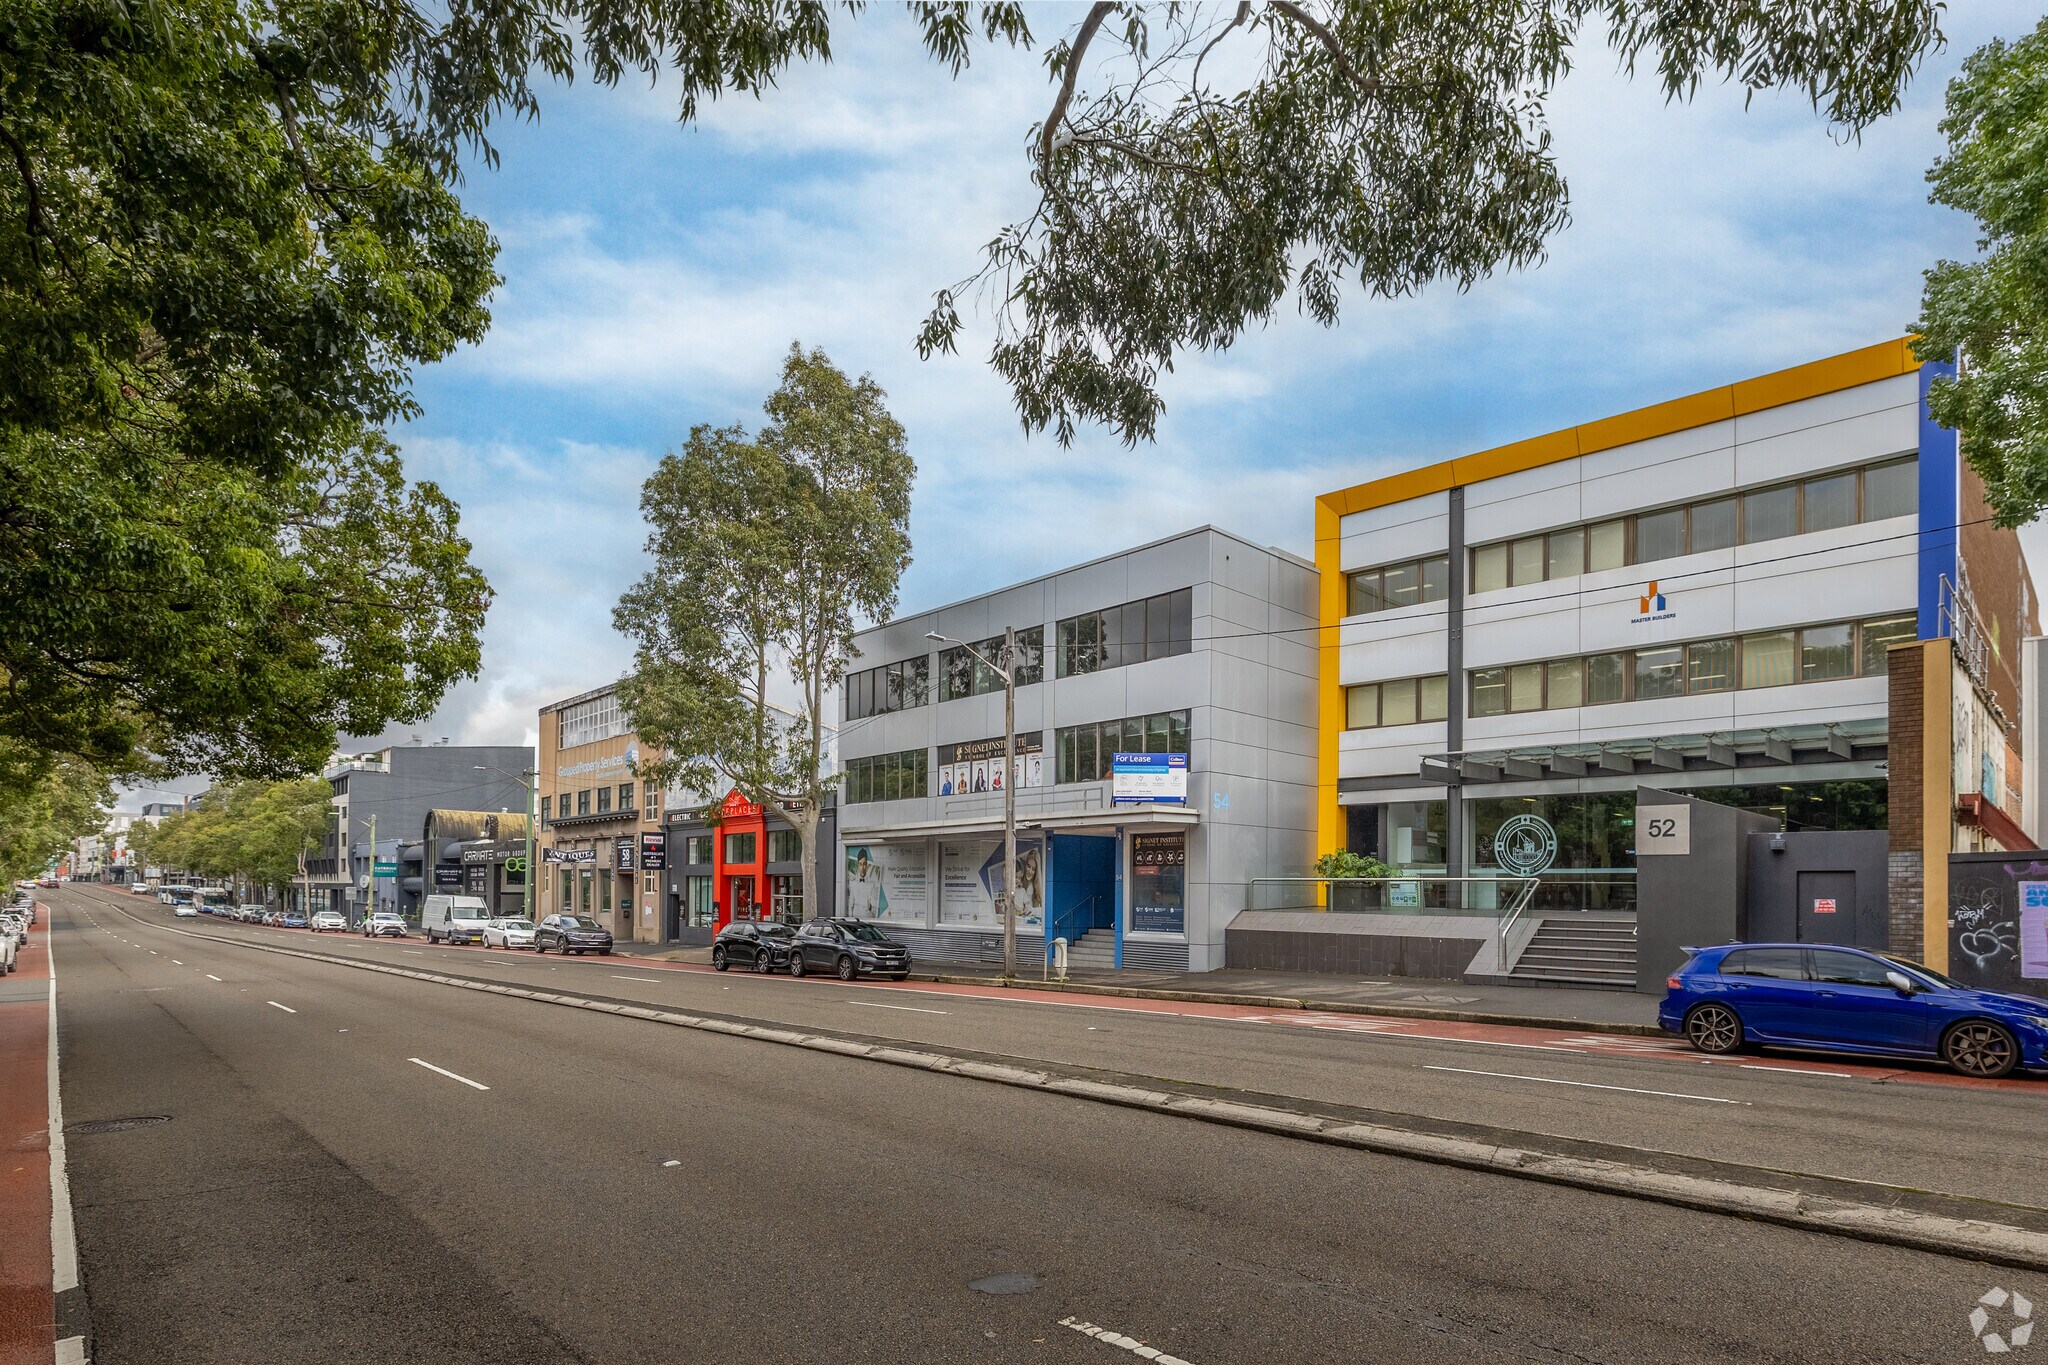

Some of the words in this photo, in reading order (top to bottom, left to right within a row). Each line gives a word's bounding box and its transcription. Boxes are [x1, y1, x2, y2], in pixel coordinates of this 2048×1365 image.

[1652, 613, 1677, 621] BUILDERS
[580, 760, 600, 774] Property
[600, 755, 624, 769] Services
[671, 812, 691, 822] ELECTRIC
[1648, 818, 1676, 838] 52
[464, 850, 494, 861] CARMATE
[622, 849, 630, 861] 58
